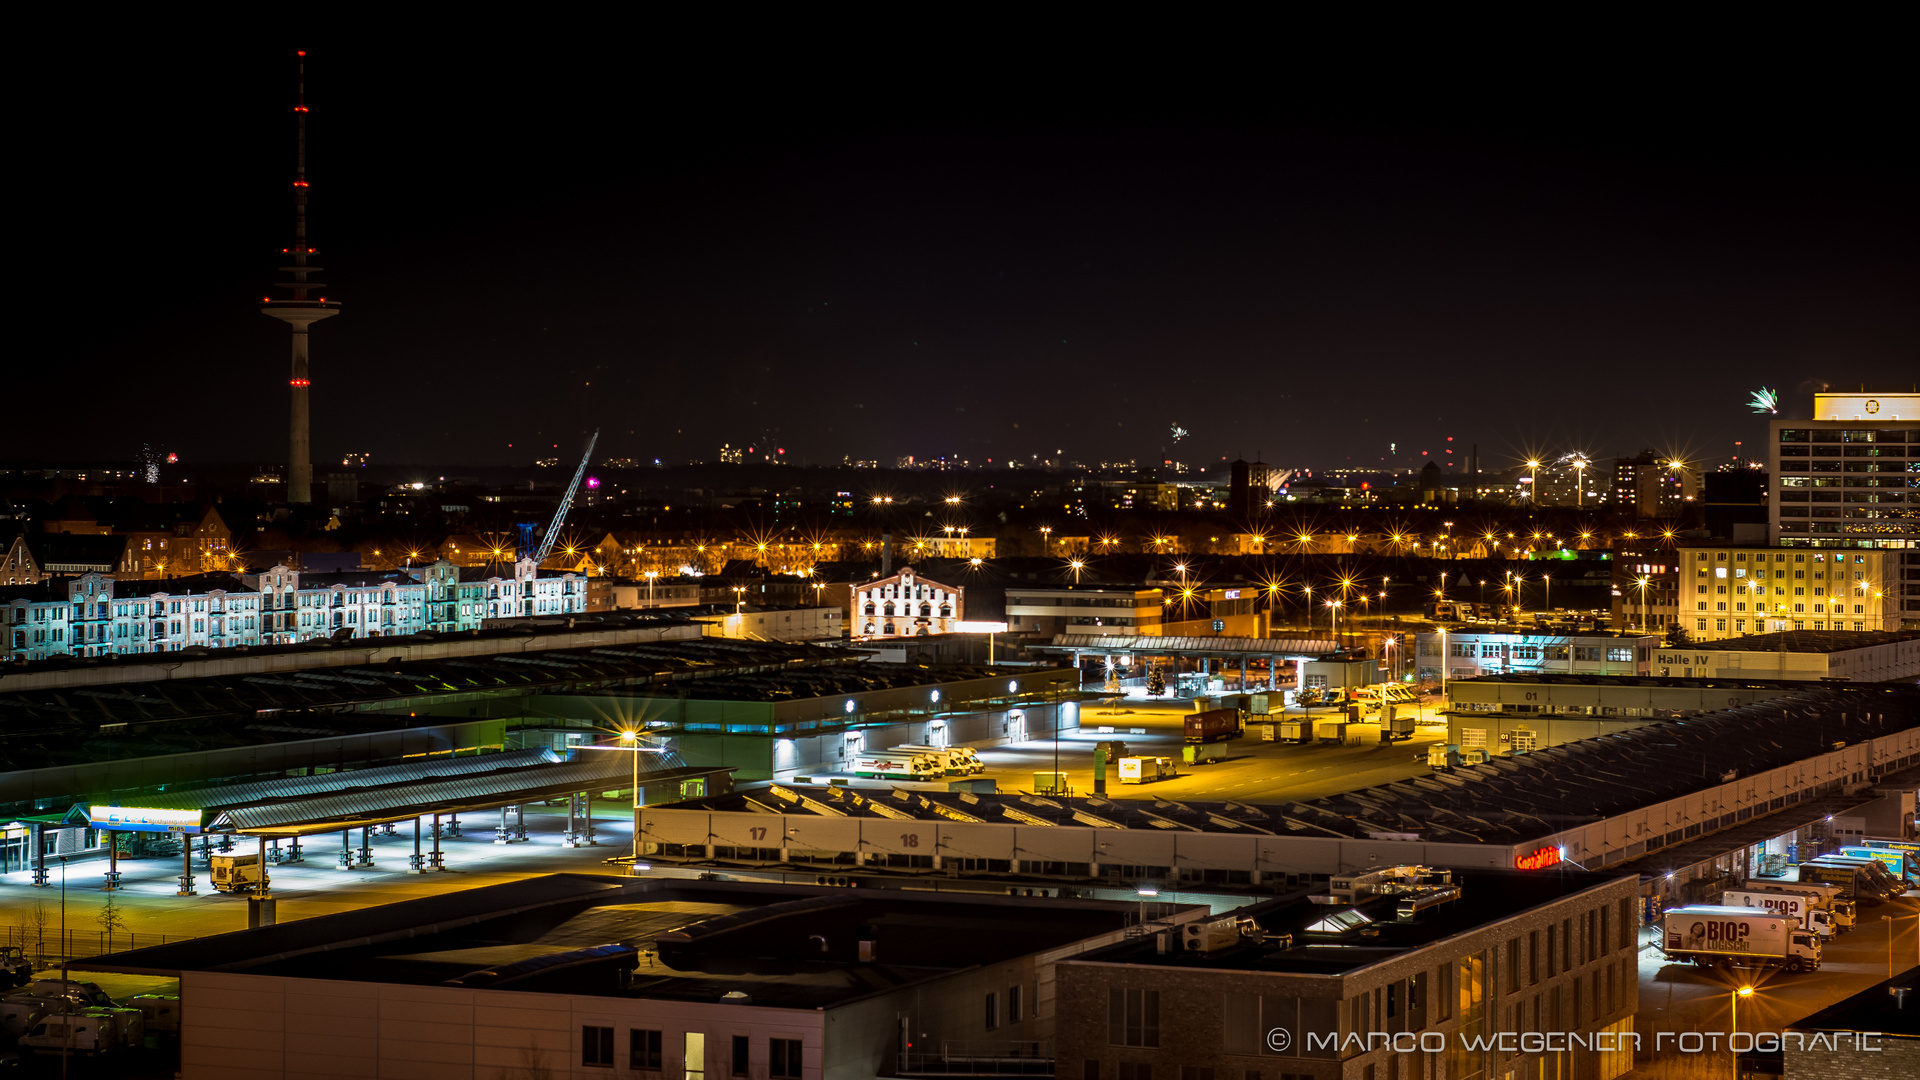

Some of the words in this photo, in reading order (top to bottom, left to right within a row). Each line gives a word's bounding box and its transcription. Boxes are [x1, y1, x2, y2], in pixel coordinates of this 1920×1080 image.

[1658, 654, 1690, 665] Halle
[1696, 655, 1709, 665] IV
[1525, 692, 1538, 701] 01
[1728, 697, 1741, 708] 02
[749, 827, 767, 841] 17
[900, 833, 919, 848] 18
[1707, 920, 1750, 942] BIO?
[1707, 940, 1750, 952] LOGISCH!
